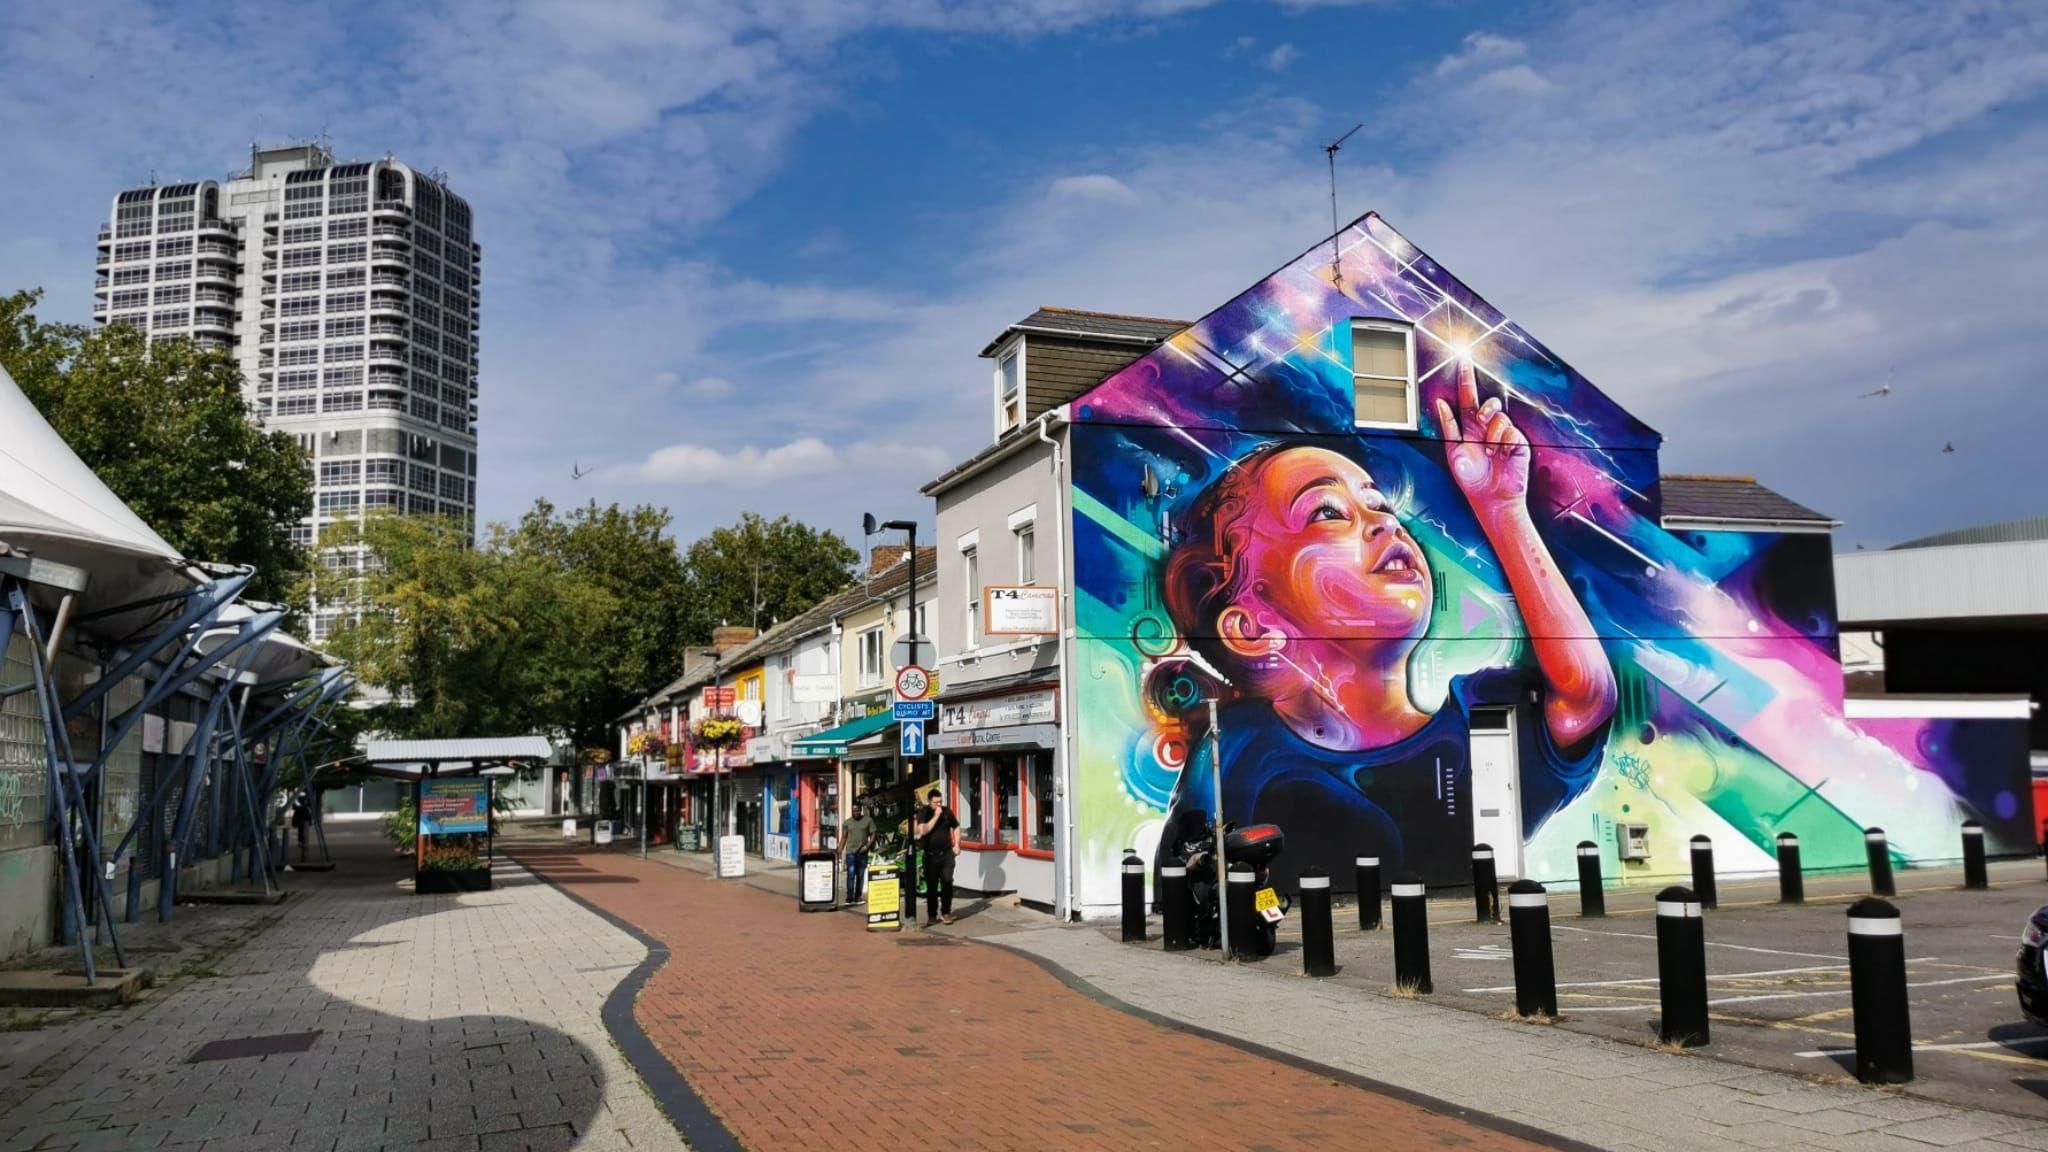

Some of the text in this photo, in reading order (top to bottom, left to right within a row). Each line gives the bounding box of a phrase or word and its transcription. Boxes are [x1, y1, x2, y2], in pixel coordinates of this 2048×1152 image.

[991, 589, 1020, 600] T4
[945, 705, 966, 727] T4
[1266, 909, 1278, 918] L
